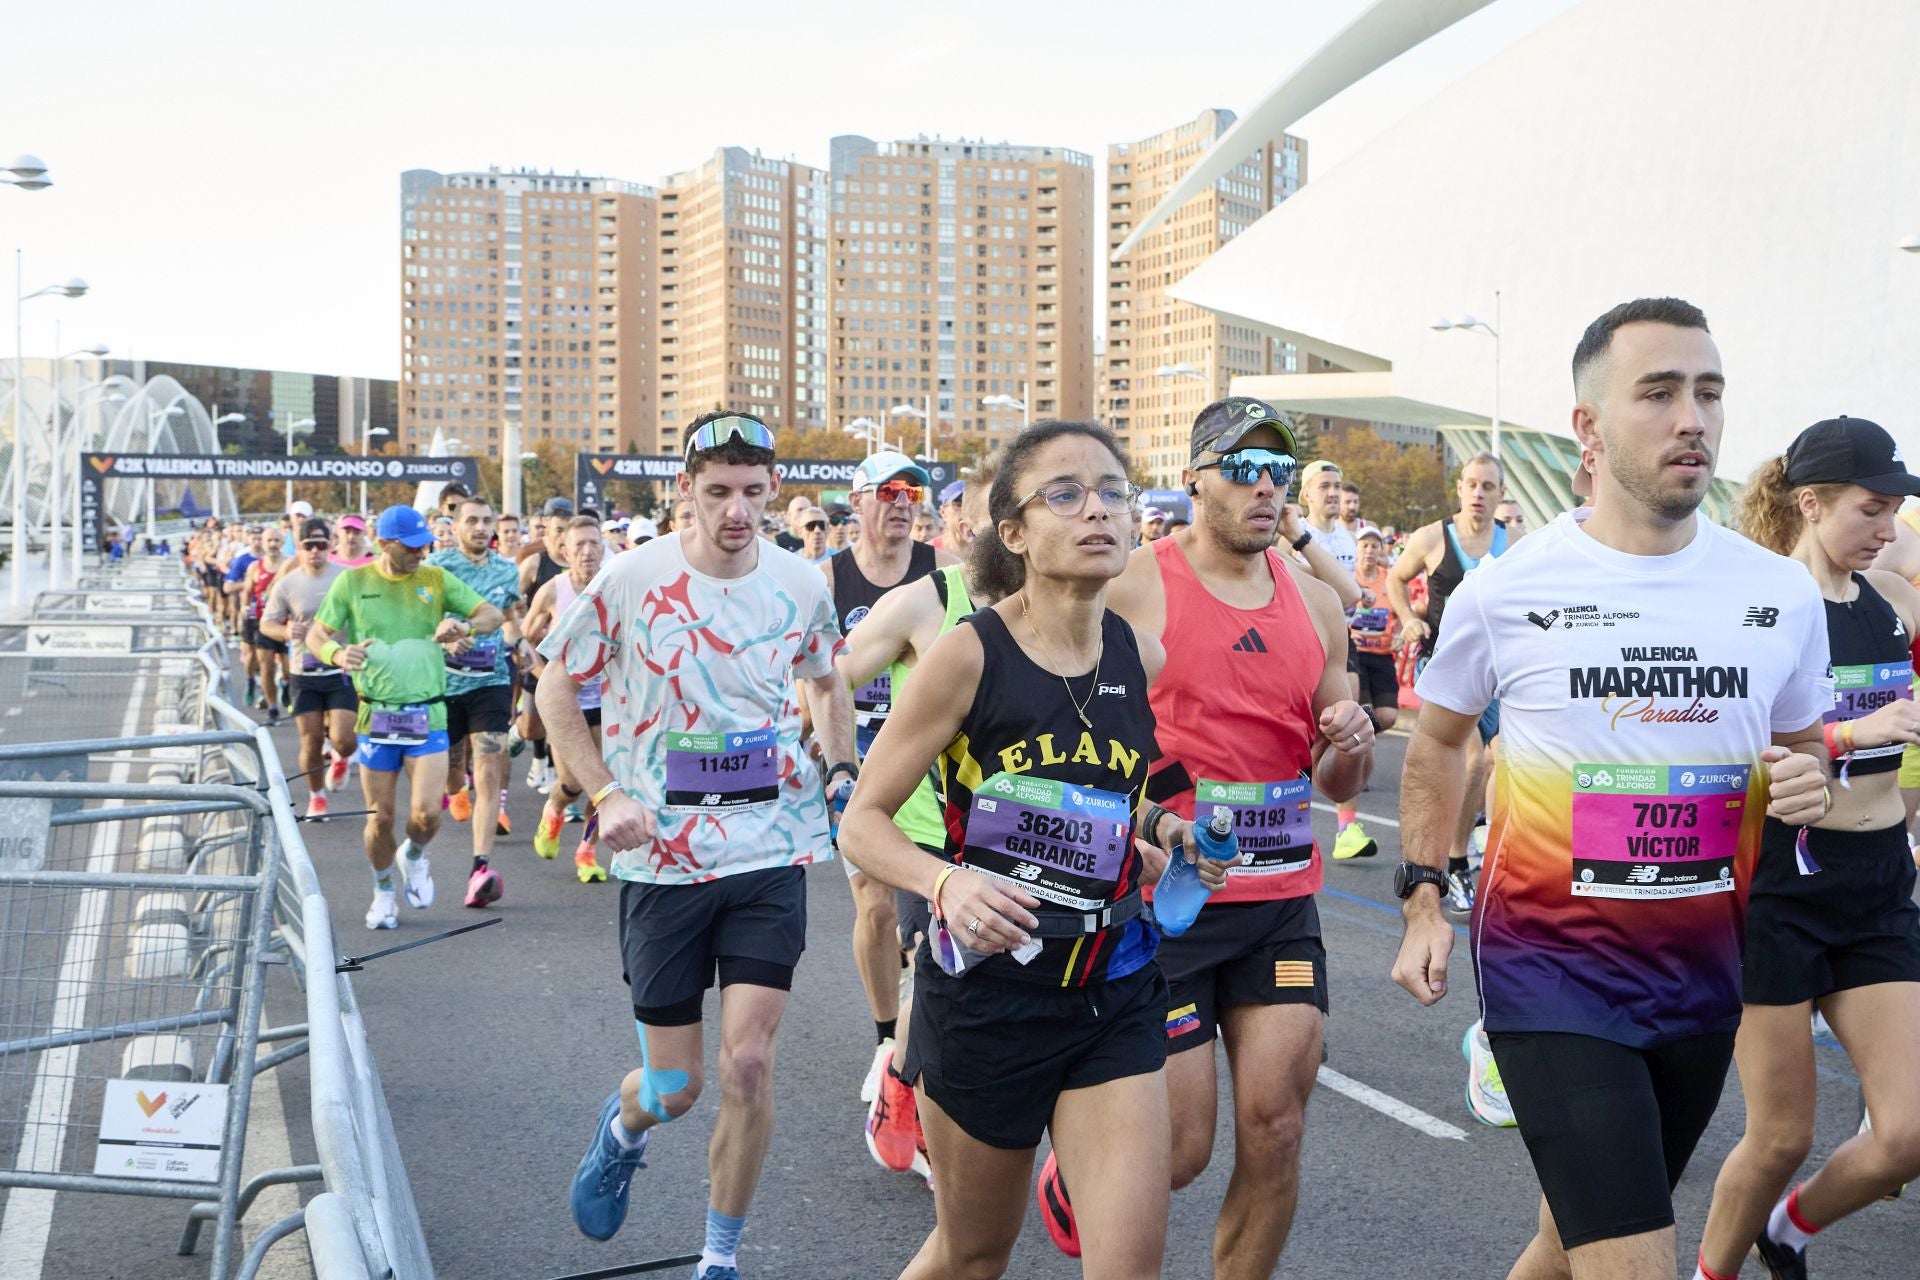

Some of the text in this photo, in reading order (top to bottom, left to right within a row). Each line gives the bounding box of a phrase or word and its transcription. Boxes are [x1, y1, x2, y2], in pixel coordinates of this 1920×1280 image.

[113, 457, 448, 477] 42K VALENCIA TRINIDAD ALFONSO ZURICH
[613, 459, 687, 476] 42K VALEN
[787, 464, 858, 481] ALFONS
[1562, 604, 1599, 614] VALENCIA
[1602, 611, 1640, 620] ALFONSO
[1621, 646, 1698, 662] VALENCIA
[1098, 684, 1126, 696] poli
[1569, 665, 1749, 699] MARATHON
[866, 690, 891, 702] Séba
[1601, 691, 1720, 731] Paradise
[744, 734, 768, 744] ZURICH
[997, 731, 1141, 779] ELAN
[699, 754, 750, 773] 11437
[1616, 775, 1656, 783] TRINIDAD
[1616, 782, 1656, 790] ALFONSO
[1699, 774, 1734, 784] ZURICH
[1015, 791, 1051, 804] ALFONSO
[1016, 784, 1053, 797] TRINIDAD
[1284, 785, 1305, 796] ZURICH
[1085, 796, 1116, 810] ZURICH
[1233, 807, 1286, 828] 13193
[1633, 802, 1698, 828] 7073
[1016, 810, 1093, 845] 36203
[1238, 832, 1291, 848] ernando
[1627, 831, 1700, 858] VÍCTOR
[1005, 835, 1097, 874] GARANCE
[1241, 852, 1255, 866] B
[1039, 878, 1082, 895] new balance
[1674, 874, 1698, 883] balance
[1014, 882, 1045, 897] TRINIDAD
[1045, 891, 1078, 905] ALFONSO
[1604, 887, 1633, 895] VALENCIA
[1633, 887, 1668, 895] TRINIDAD
[1668, 885, 1696, 894] ALFONSO
